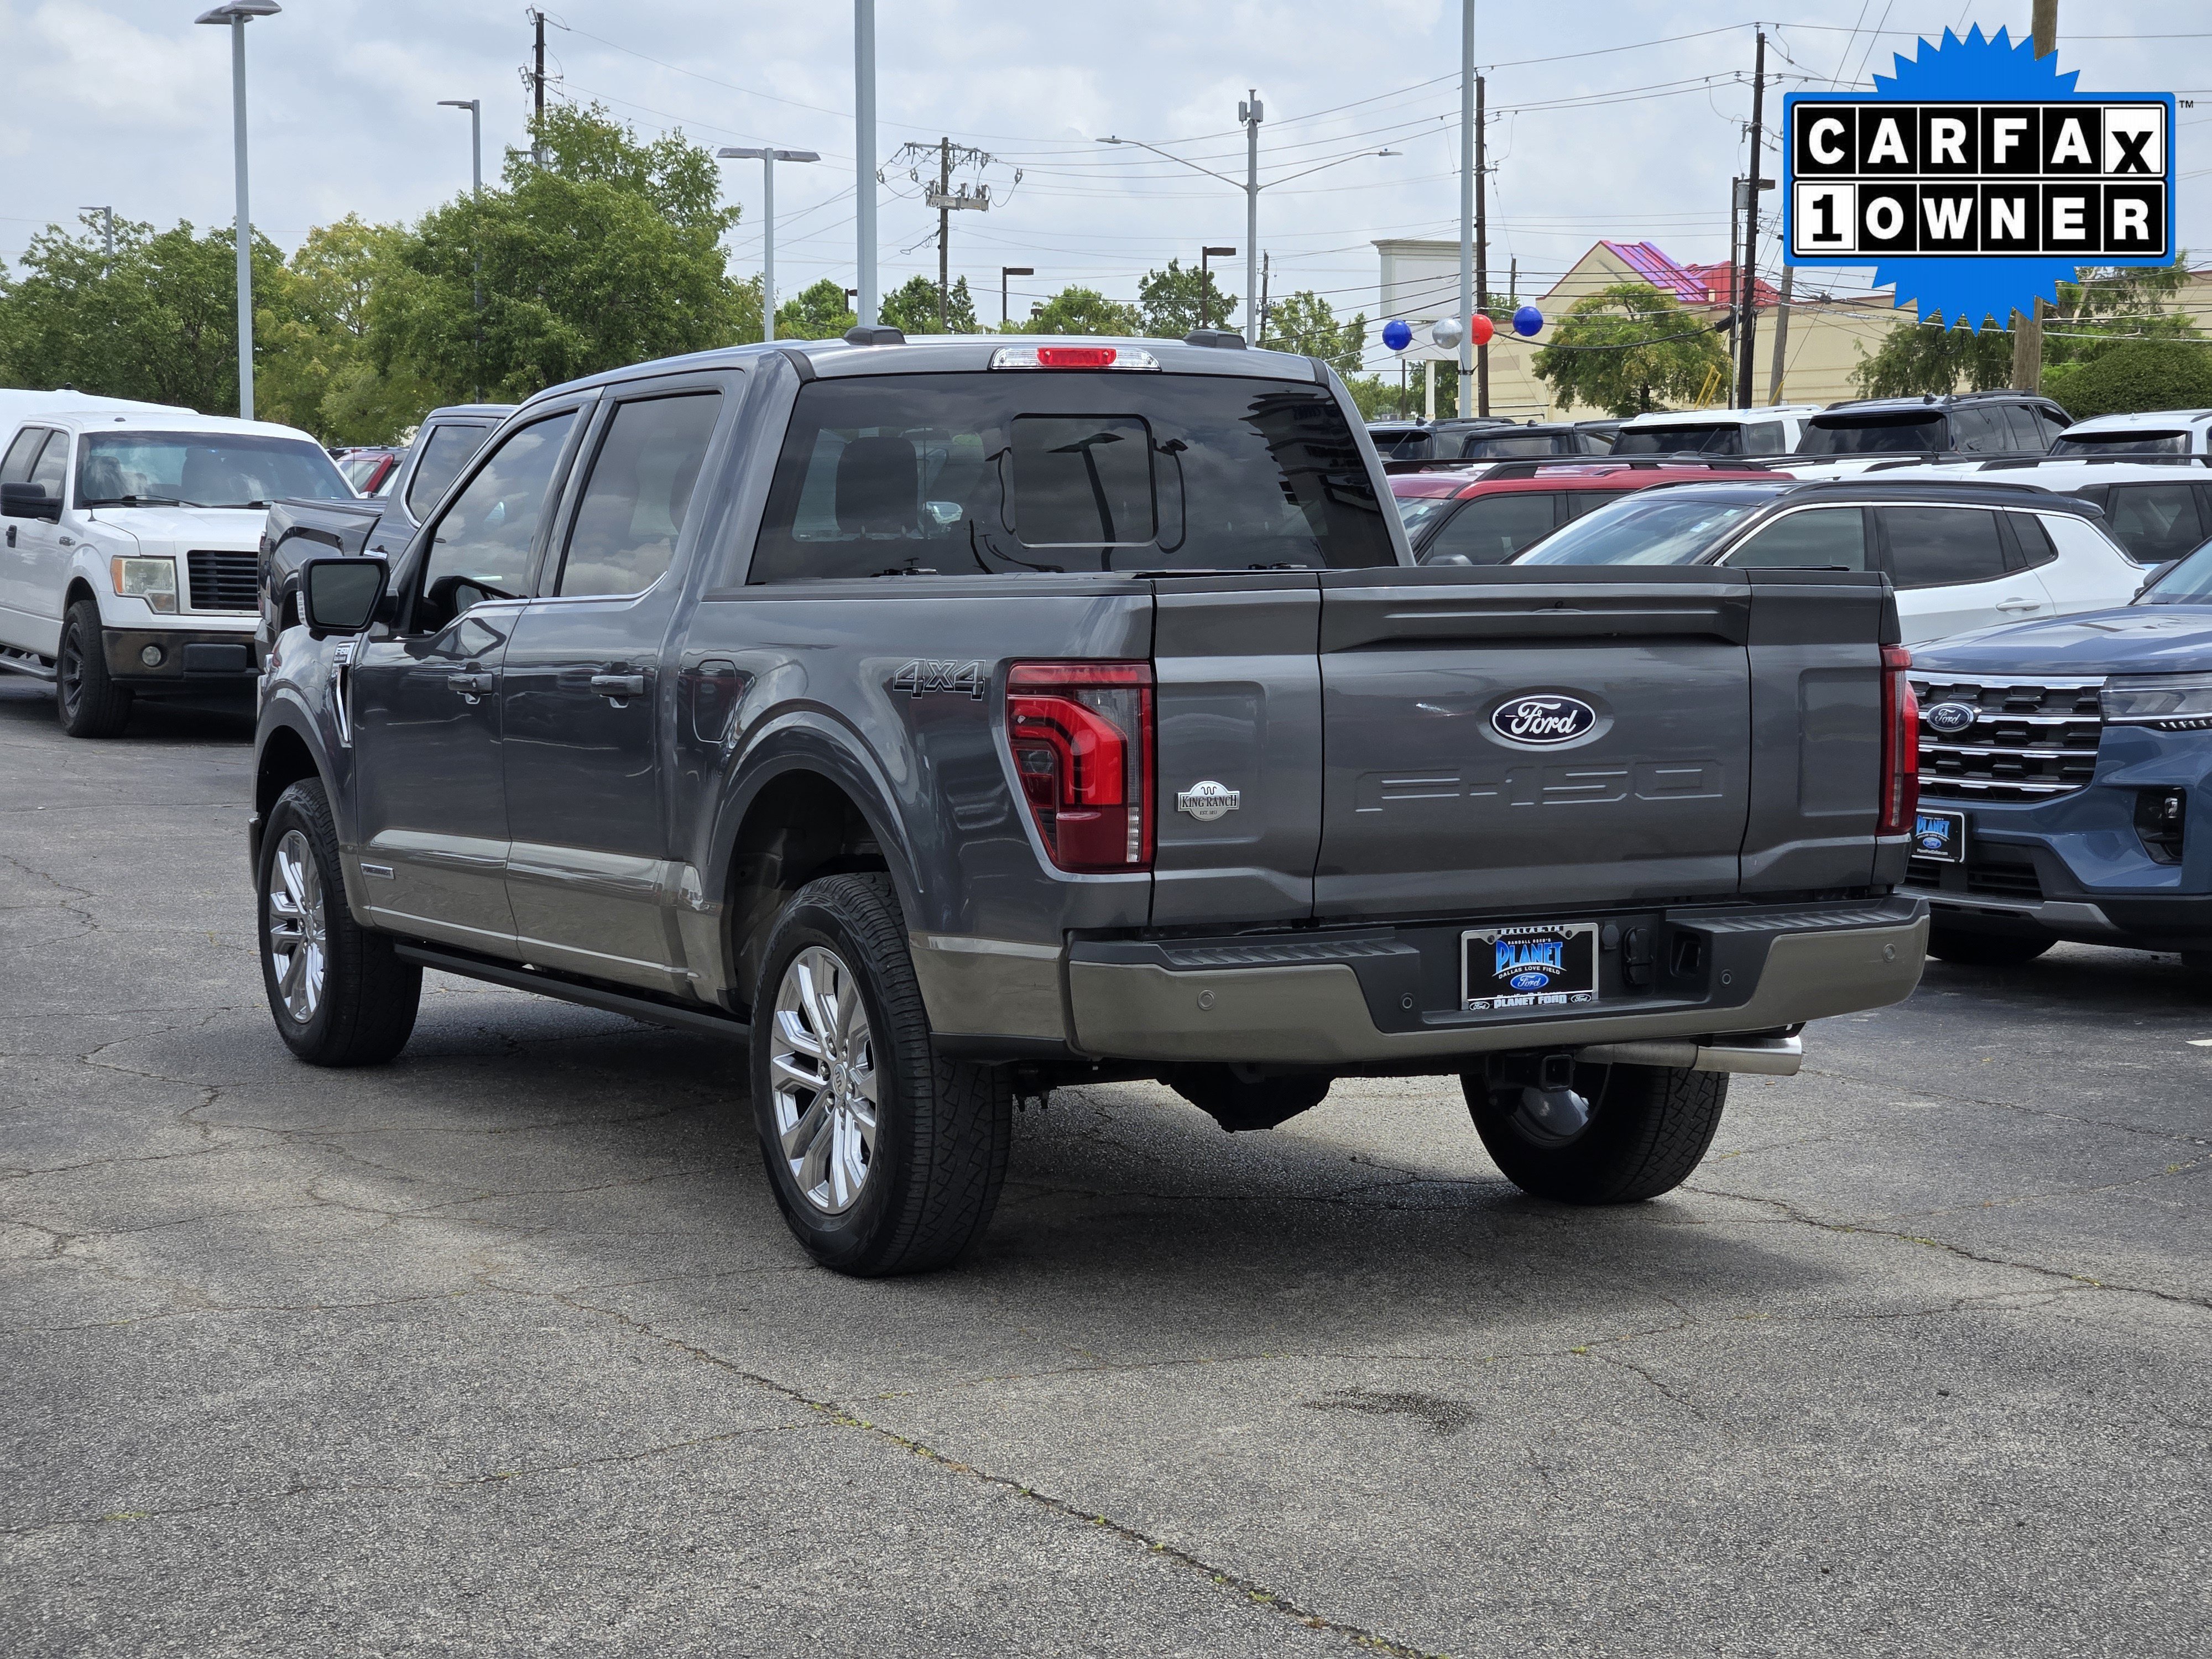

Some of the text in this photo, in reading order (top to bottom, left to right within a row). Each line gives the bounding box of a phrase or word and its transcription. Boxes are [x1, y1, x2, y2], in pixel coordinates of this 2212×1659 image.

[1511, 702, 1578, 734] Ford
[1935, 708, 1961, 724] Ford
[1182, 795, 1237, 808] KING RANCH
[1916, 815, 1950, 837] PLANET
[1496, 940, 1563, 973] PLANET
[1499, 968, 1522, 979] DALLAS
[1542, 967, 1561, 975] FIELD
[1517, 975, 1541, 987] Ford
[1494, 997, 1535, 1009] PLANET
[1538, 994, 1567, 1005] FORD
